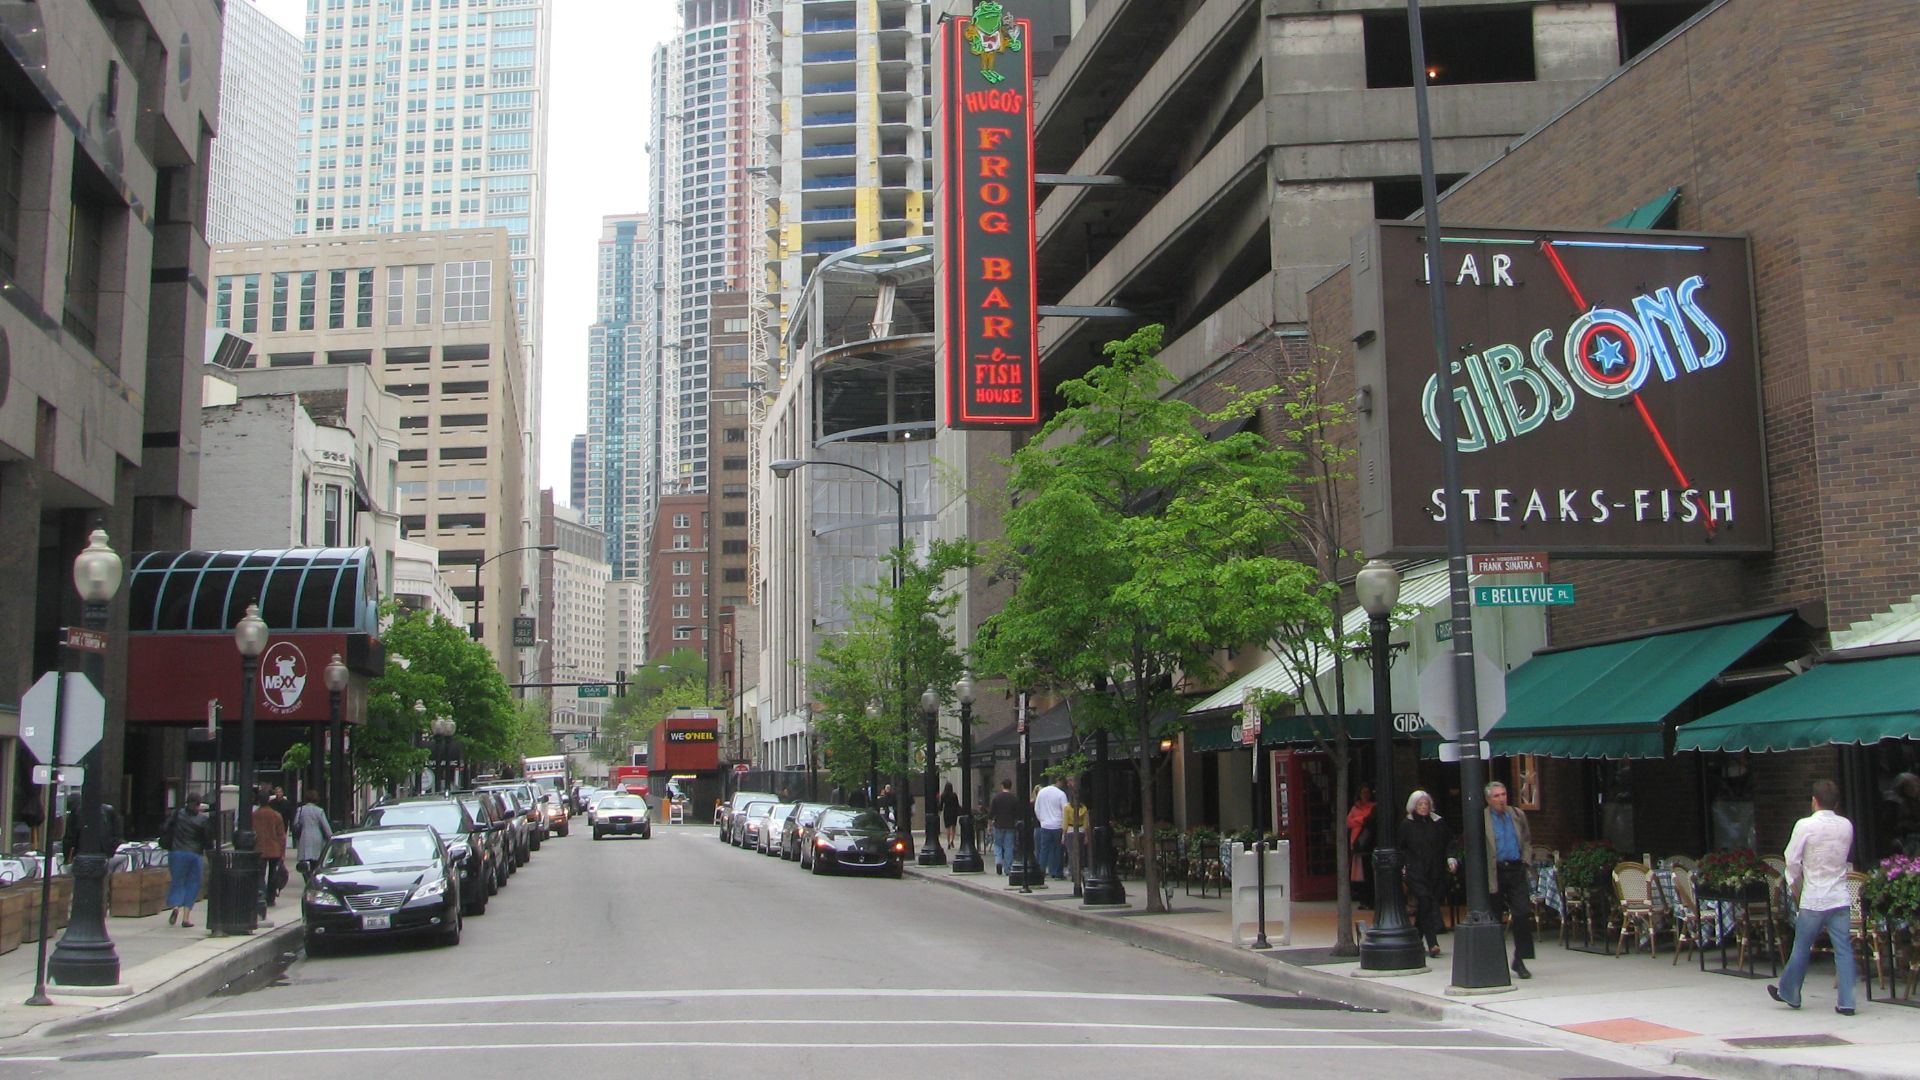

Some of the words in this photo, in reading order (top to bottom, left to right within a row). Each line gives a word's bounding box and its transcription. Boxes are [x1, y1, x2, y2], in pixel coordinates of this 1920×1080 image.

[965, 88, 1023, 114] HUGO'S
[977, 128, 1011, 234] FROG
[1424, 253, 1514, 286] AR
[982, 257, 1014, 338] BAR
[975, 364, 1022, 385] FISH
[1421, 275, 1728, 453] GIBSONS
[976, 388, 1023, 403] HOUSE
[1479, 562, 1503, 572] FRANK
[1505, 560, 1534, 571] SINATRA
[1481, 591, 1488, 601] E
[1491, 587, 1554, 604] BELLEVUE
[1558, 590, 1569, 599] PL
[514, 637, 534, 645] PARK
